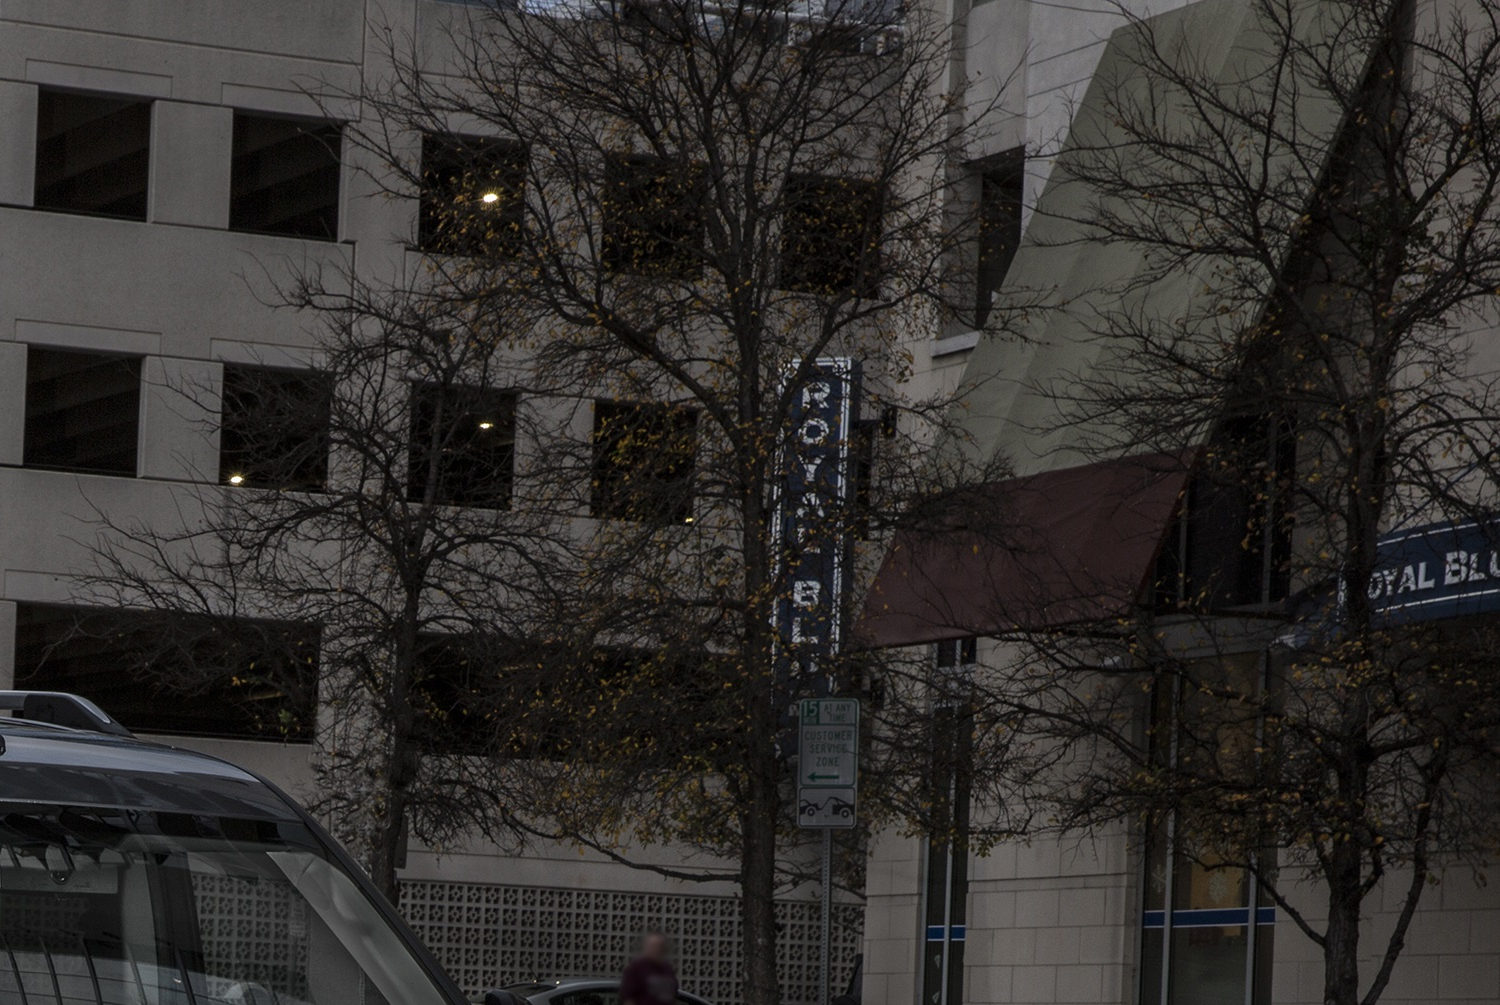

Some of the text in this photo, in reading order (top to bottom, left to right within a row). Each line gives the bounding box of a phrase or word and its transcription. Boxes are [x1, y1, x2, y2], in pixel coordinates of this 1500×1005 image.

[1366, 561, 1436, 600] OYAL
[804, 701, 818, 717] 15
[824, 703, 851, 712] AT ANY
[829, 713, 846, 722] TIME
[804, 730, 853, 741] CUSTOMER
[809, 743, 848, 754] SERVICE
[816, 756, 840, 767] ZONE
